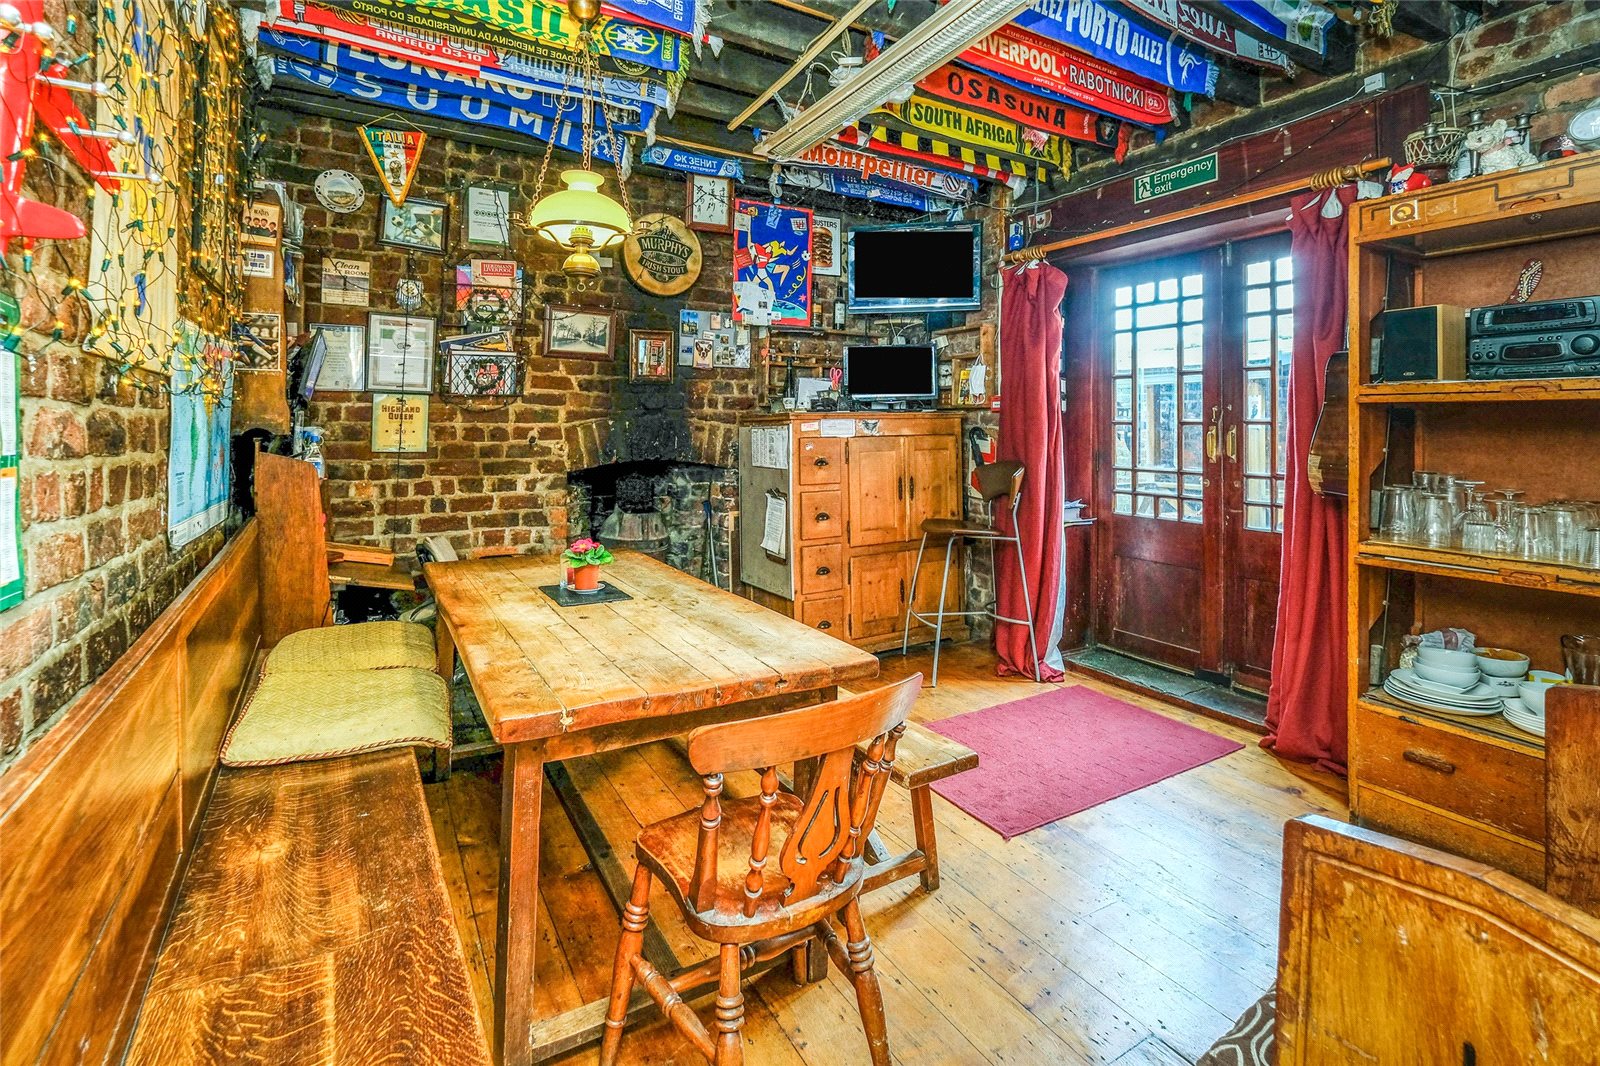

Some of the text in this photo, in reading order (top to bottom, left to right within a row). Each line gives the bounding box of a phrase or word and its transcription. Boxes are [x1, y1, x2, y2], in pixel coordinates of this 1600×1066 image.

[462, 0, 570, 38] ASIL
[674, 0, 684, 21] EVER
[1066, 0, 1130, 56] PORTO
[1130, 32, 1164, 65] ALLEZ
[376, 30, 482, 62] ANFIELD 03-10
[974, 35, 1061, 78] LIVERPOOL
[1069, 64, 1144, 107] RABOTNICKI
[646, 80, 658, 99] MARS
[947, 71, 1067, 129] OSASUNA
[352, 72, 572, 145] SUOMI
[913, 103, 1015, 145] SOUTH AFRICA
[371, 130, 415, 145] ITALIA
[674, 154, 718, 169] ФК ЗЕНИТ
[802, 143, 936, 188] Montpellier
[1154, 159, 1213, 184] Emergency
[1154, 182, 1172, 194] exit
[641, 237, 690, 258] MURPHYS
[335, 260, 360, 270] Clean
[642, 259, 685, 275] IRISH STOUT
[382, 405, 421, 413] HIGHLAND
